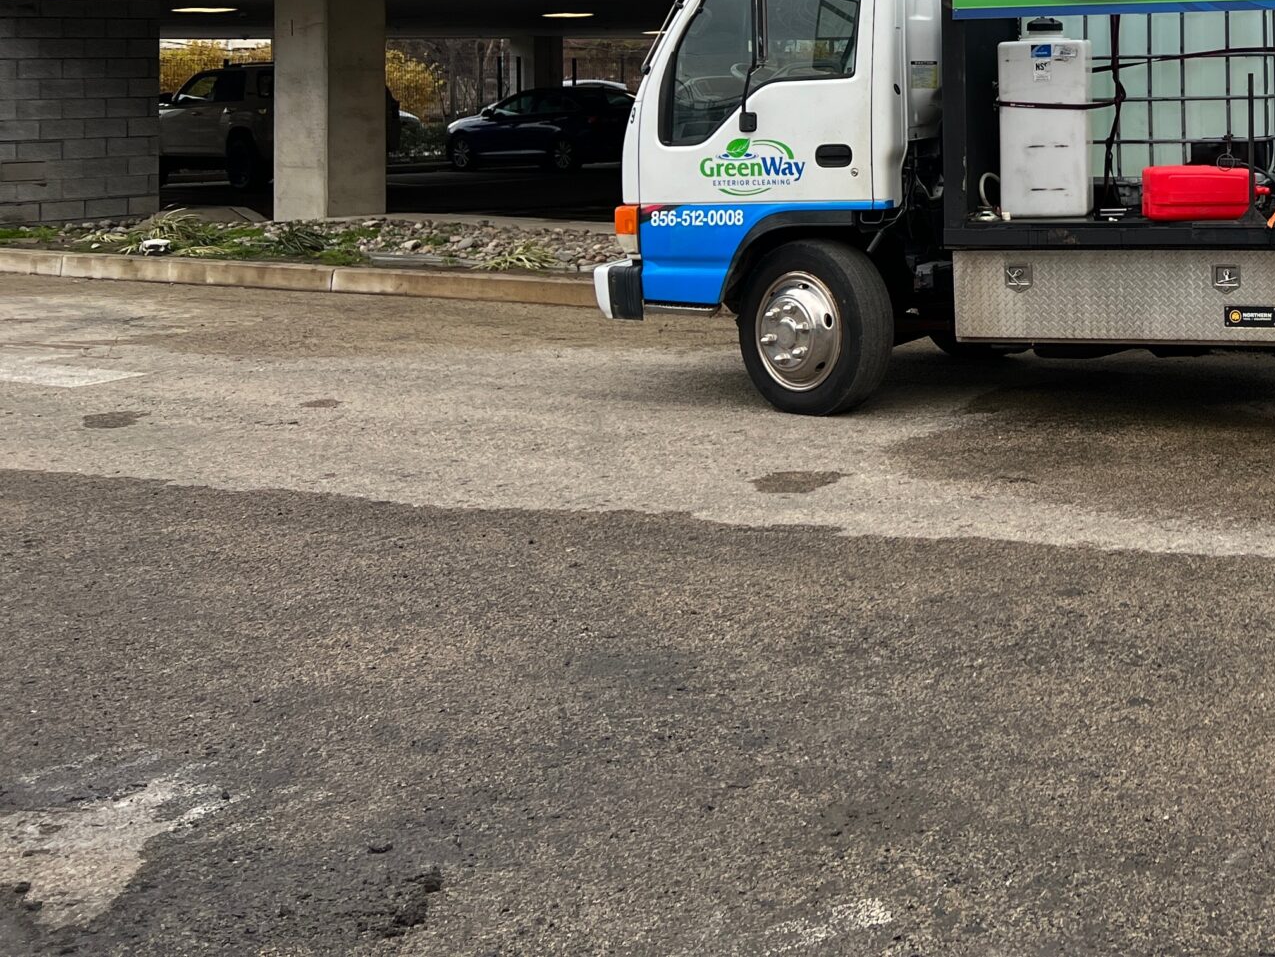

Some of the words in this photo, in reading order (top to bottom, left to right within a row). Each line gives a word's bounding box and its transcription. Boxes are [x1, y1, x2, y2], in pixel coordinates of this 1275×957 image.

[699, 156, 806, 182] GreenWay
[712, 179, 750, 187] EXTERIOR
[752, 178, 791, 186] CLEANING
[650, 210, 744, 226] 856-512-0008
